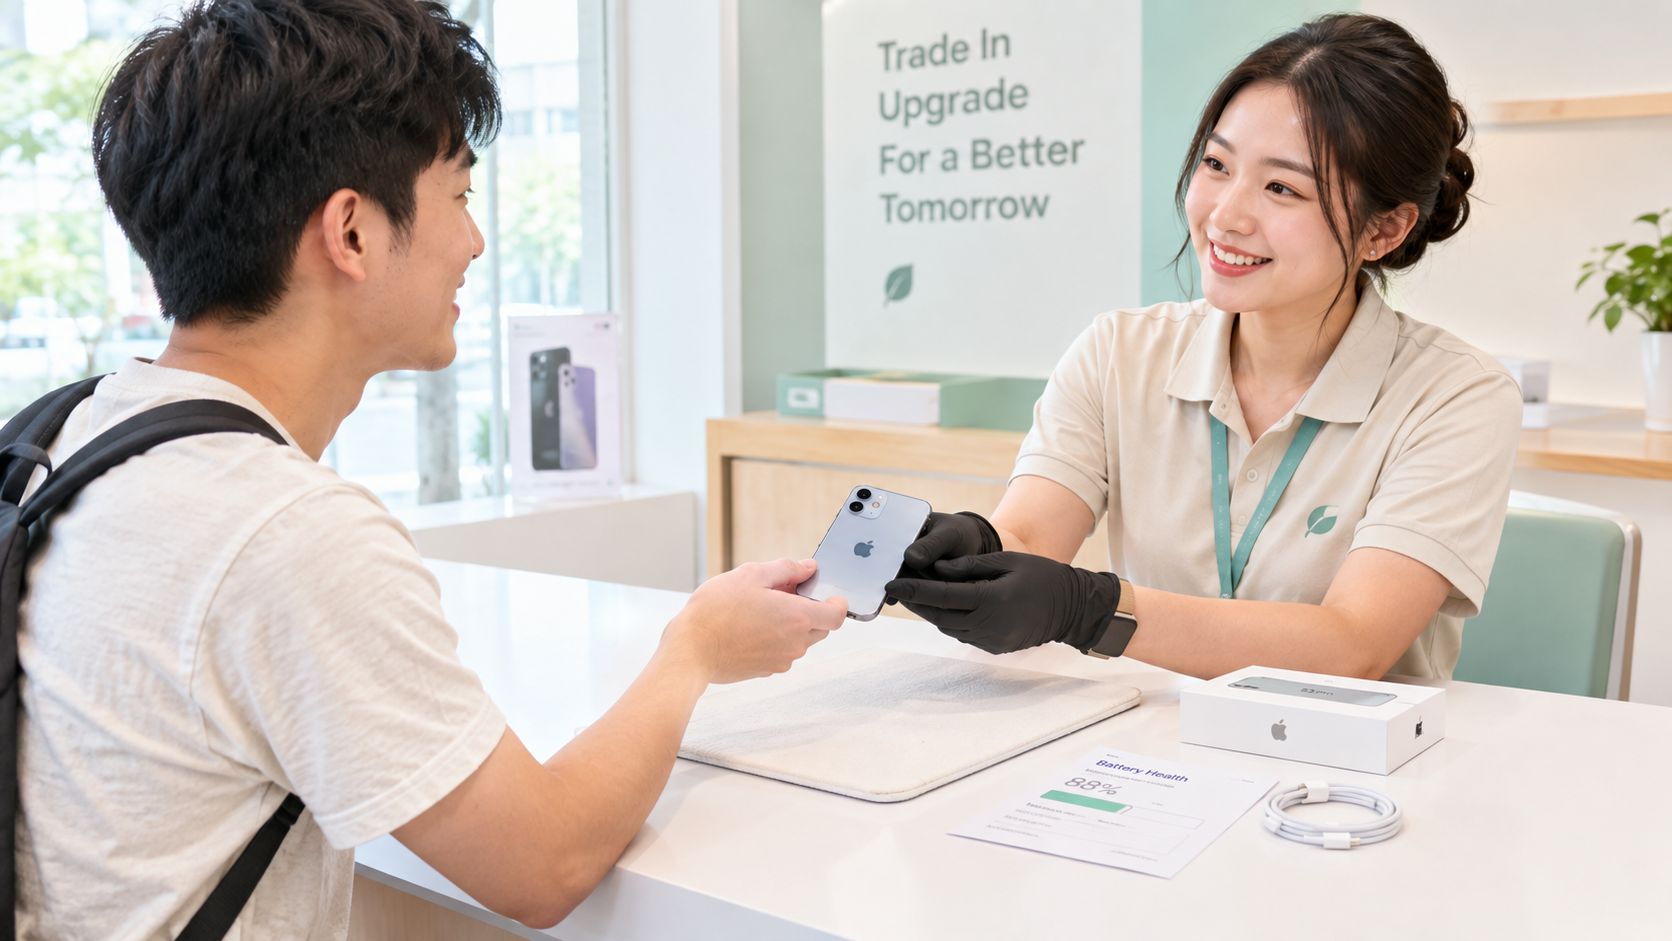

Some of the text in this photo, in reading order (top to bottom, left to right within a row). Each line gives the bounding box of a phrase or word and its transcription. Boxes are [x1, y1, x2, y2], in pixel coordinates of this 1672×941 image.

[878, 28, 1011, 72] Trade In
[879, 77, 1029, 127] Upgrade
[880, 136, 1085, 175] For a Better
[880, 194, 1050, 223] Tomorrow
[1064, 777, 1122, 795] 88%
[1096, 759, 1144, 775] Battery
[1145, 769, 1188, 783] Health
